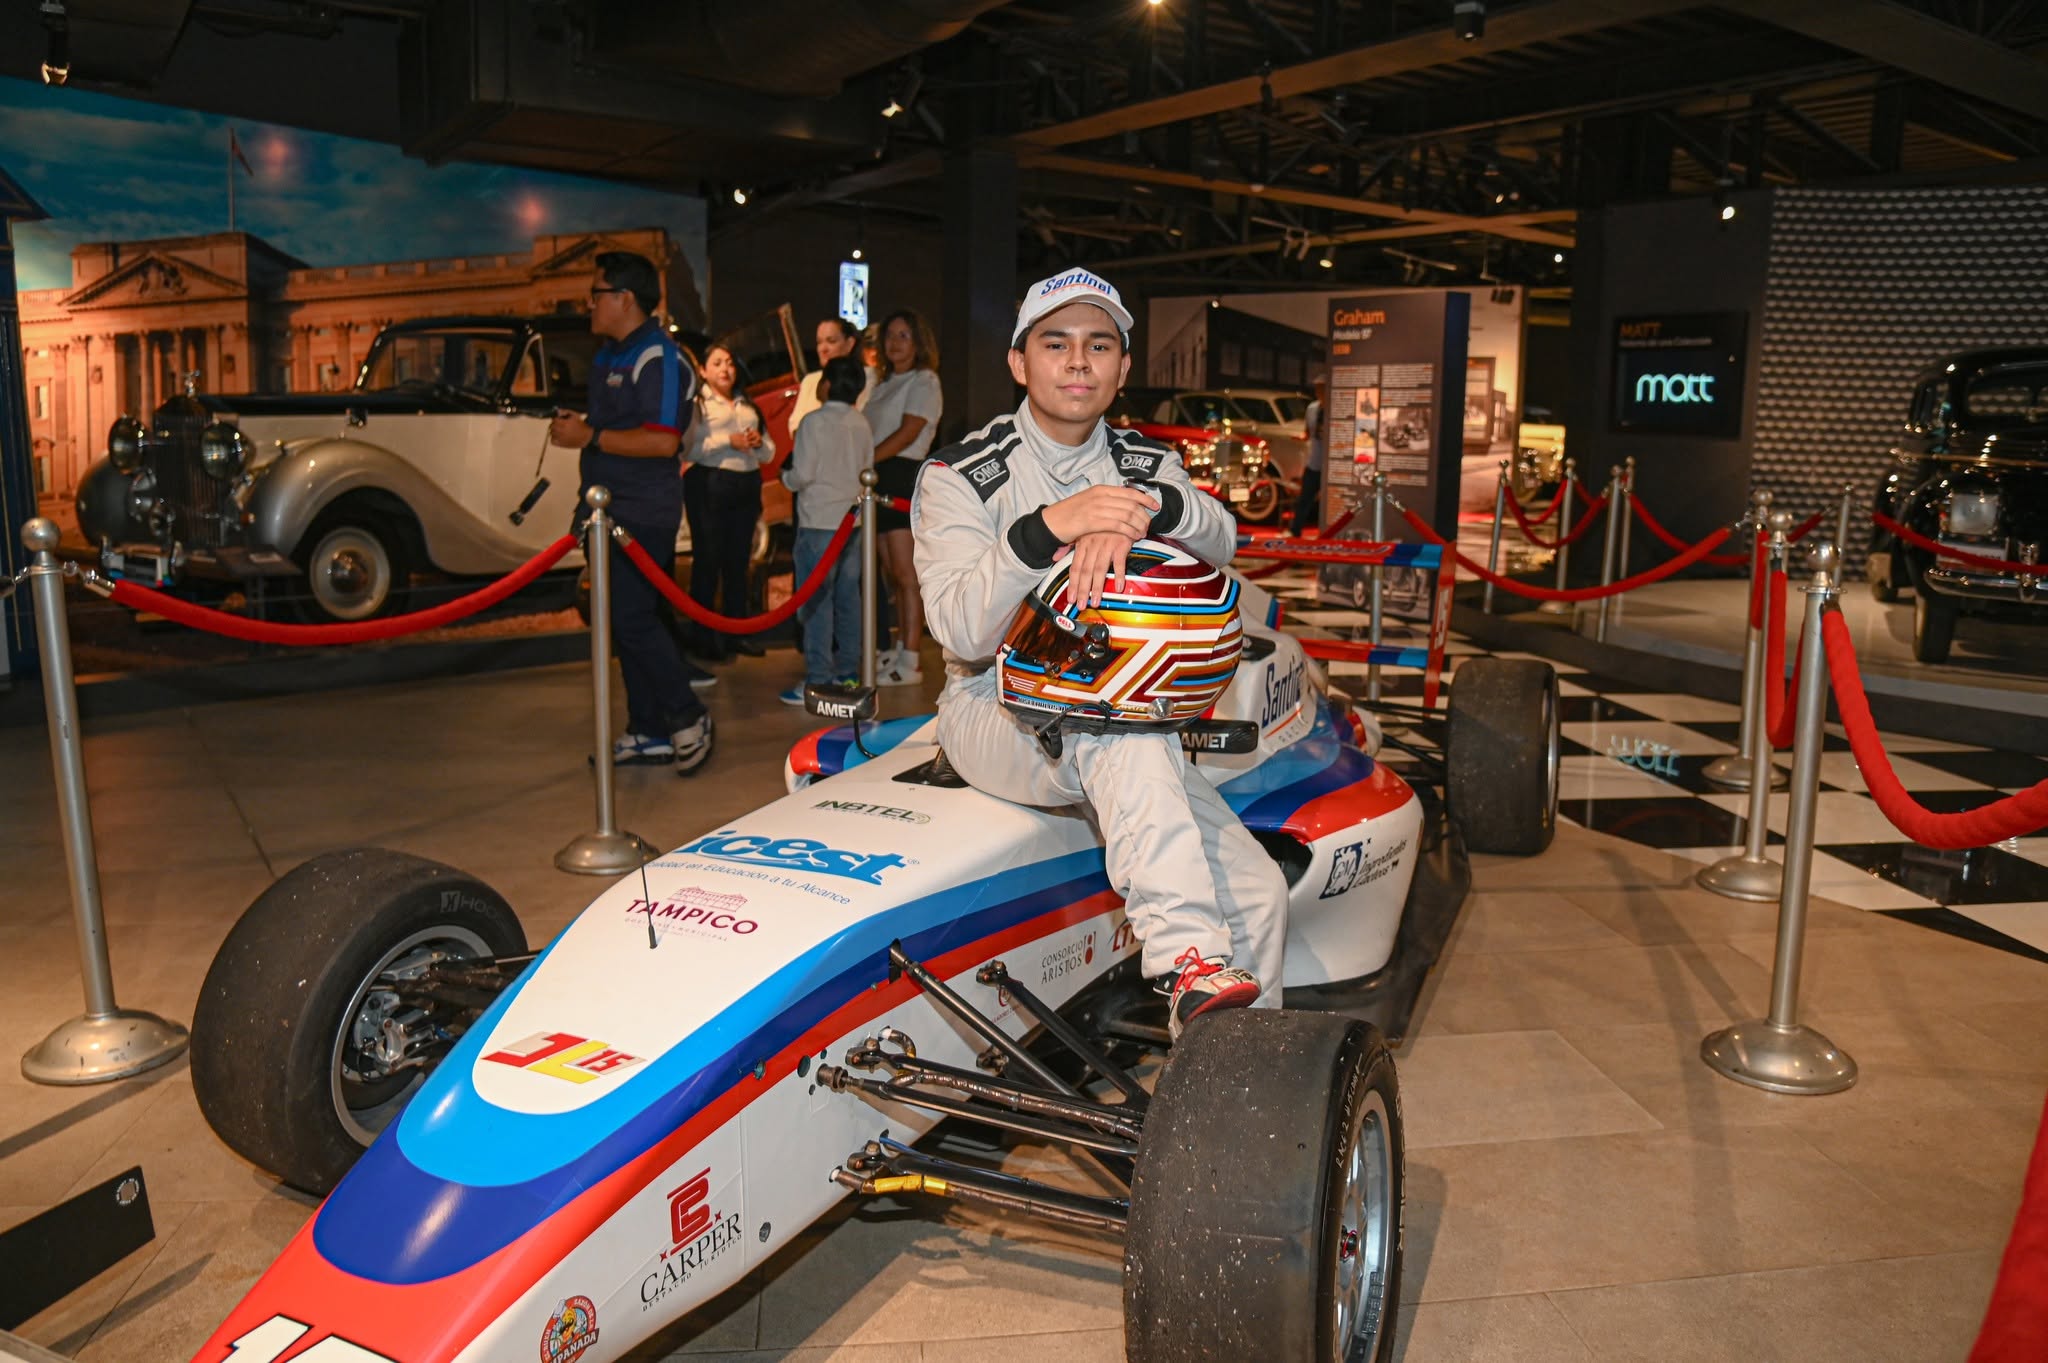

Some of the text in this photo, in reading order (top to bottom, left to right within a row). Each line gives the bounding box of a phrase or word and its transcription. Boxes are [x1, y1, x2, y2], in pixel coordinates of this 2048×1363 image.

[1334, 309, 1386, 326] Graham
[1620, 322, 1662, 337] MATT
[1636, 373, 1714, 402] matt
[973, 460, 1001, 483] OMP
[1120, 455, 1153, 468] OMP
[816, 700, 857, 718] AMET
[1181, 731, 1229, 750] AMET
[814, 800, 915, 821] INBTEL
[672, 830, 907, 885] icest
[703, 863, 768, 881] Educación
[770, 875, 780, 884] a
[781, 877, 797, 888] tu
[797, 882, 851, 905] Alcance
[626, 899, 758, 934] TAMPICO
[1041, 940, 1082, 968] CONSORCIO
[1041, 953, 1082, 985] ARISTOS
[640, 1212, 742, 1303] CARPER
[642, 1272, 692, 1312] DESPACHO
